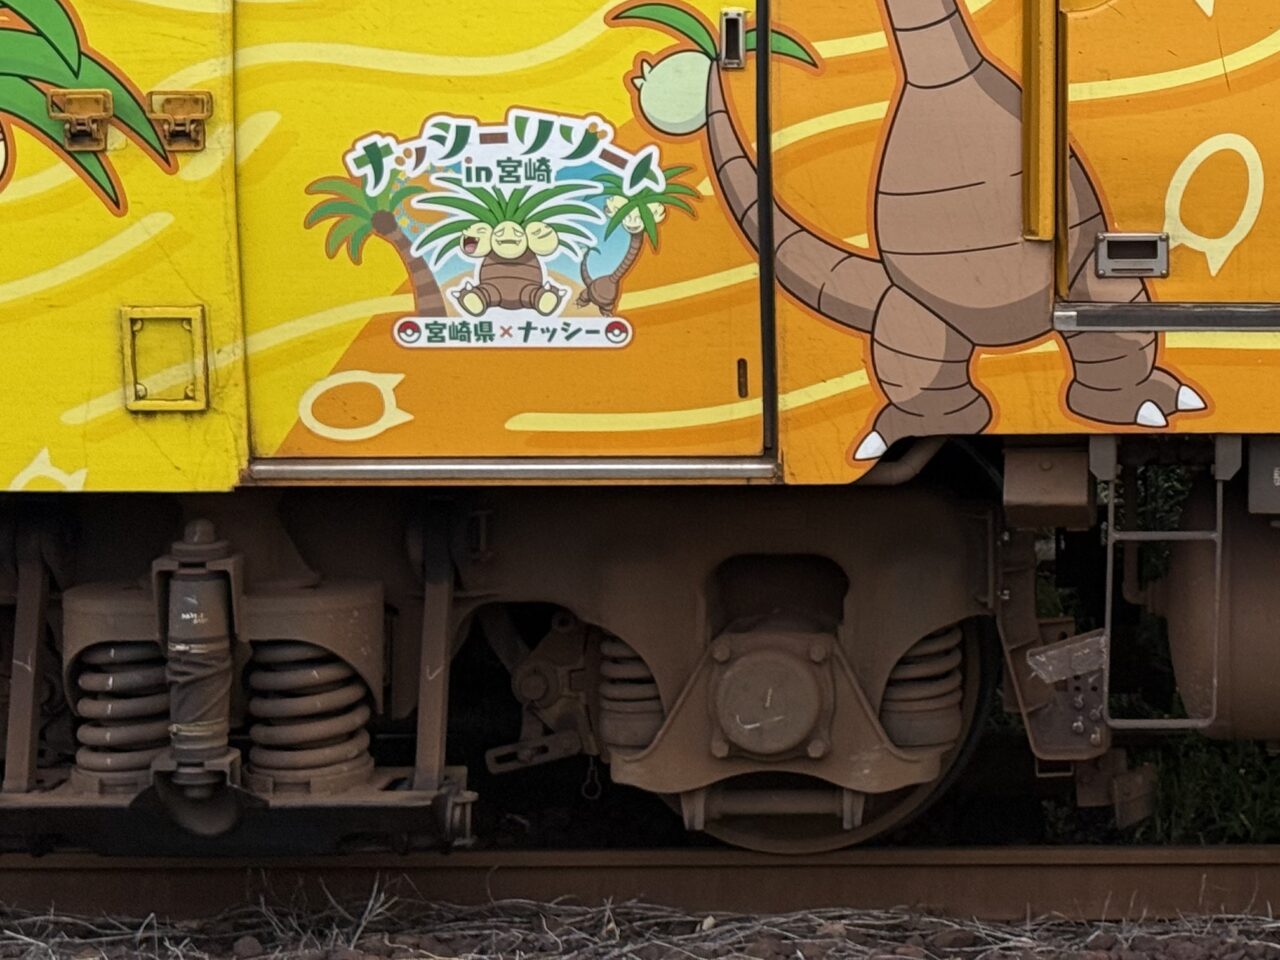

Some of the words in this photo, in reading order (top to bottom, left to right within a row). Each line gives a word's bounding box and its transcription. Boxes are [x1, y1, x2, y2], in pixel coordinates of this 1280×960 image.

[353, 114, 660, 190] ナッシーリゾート
